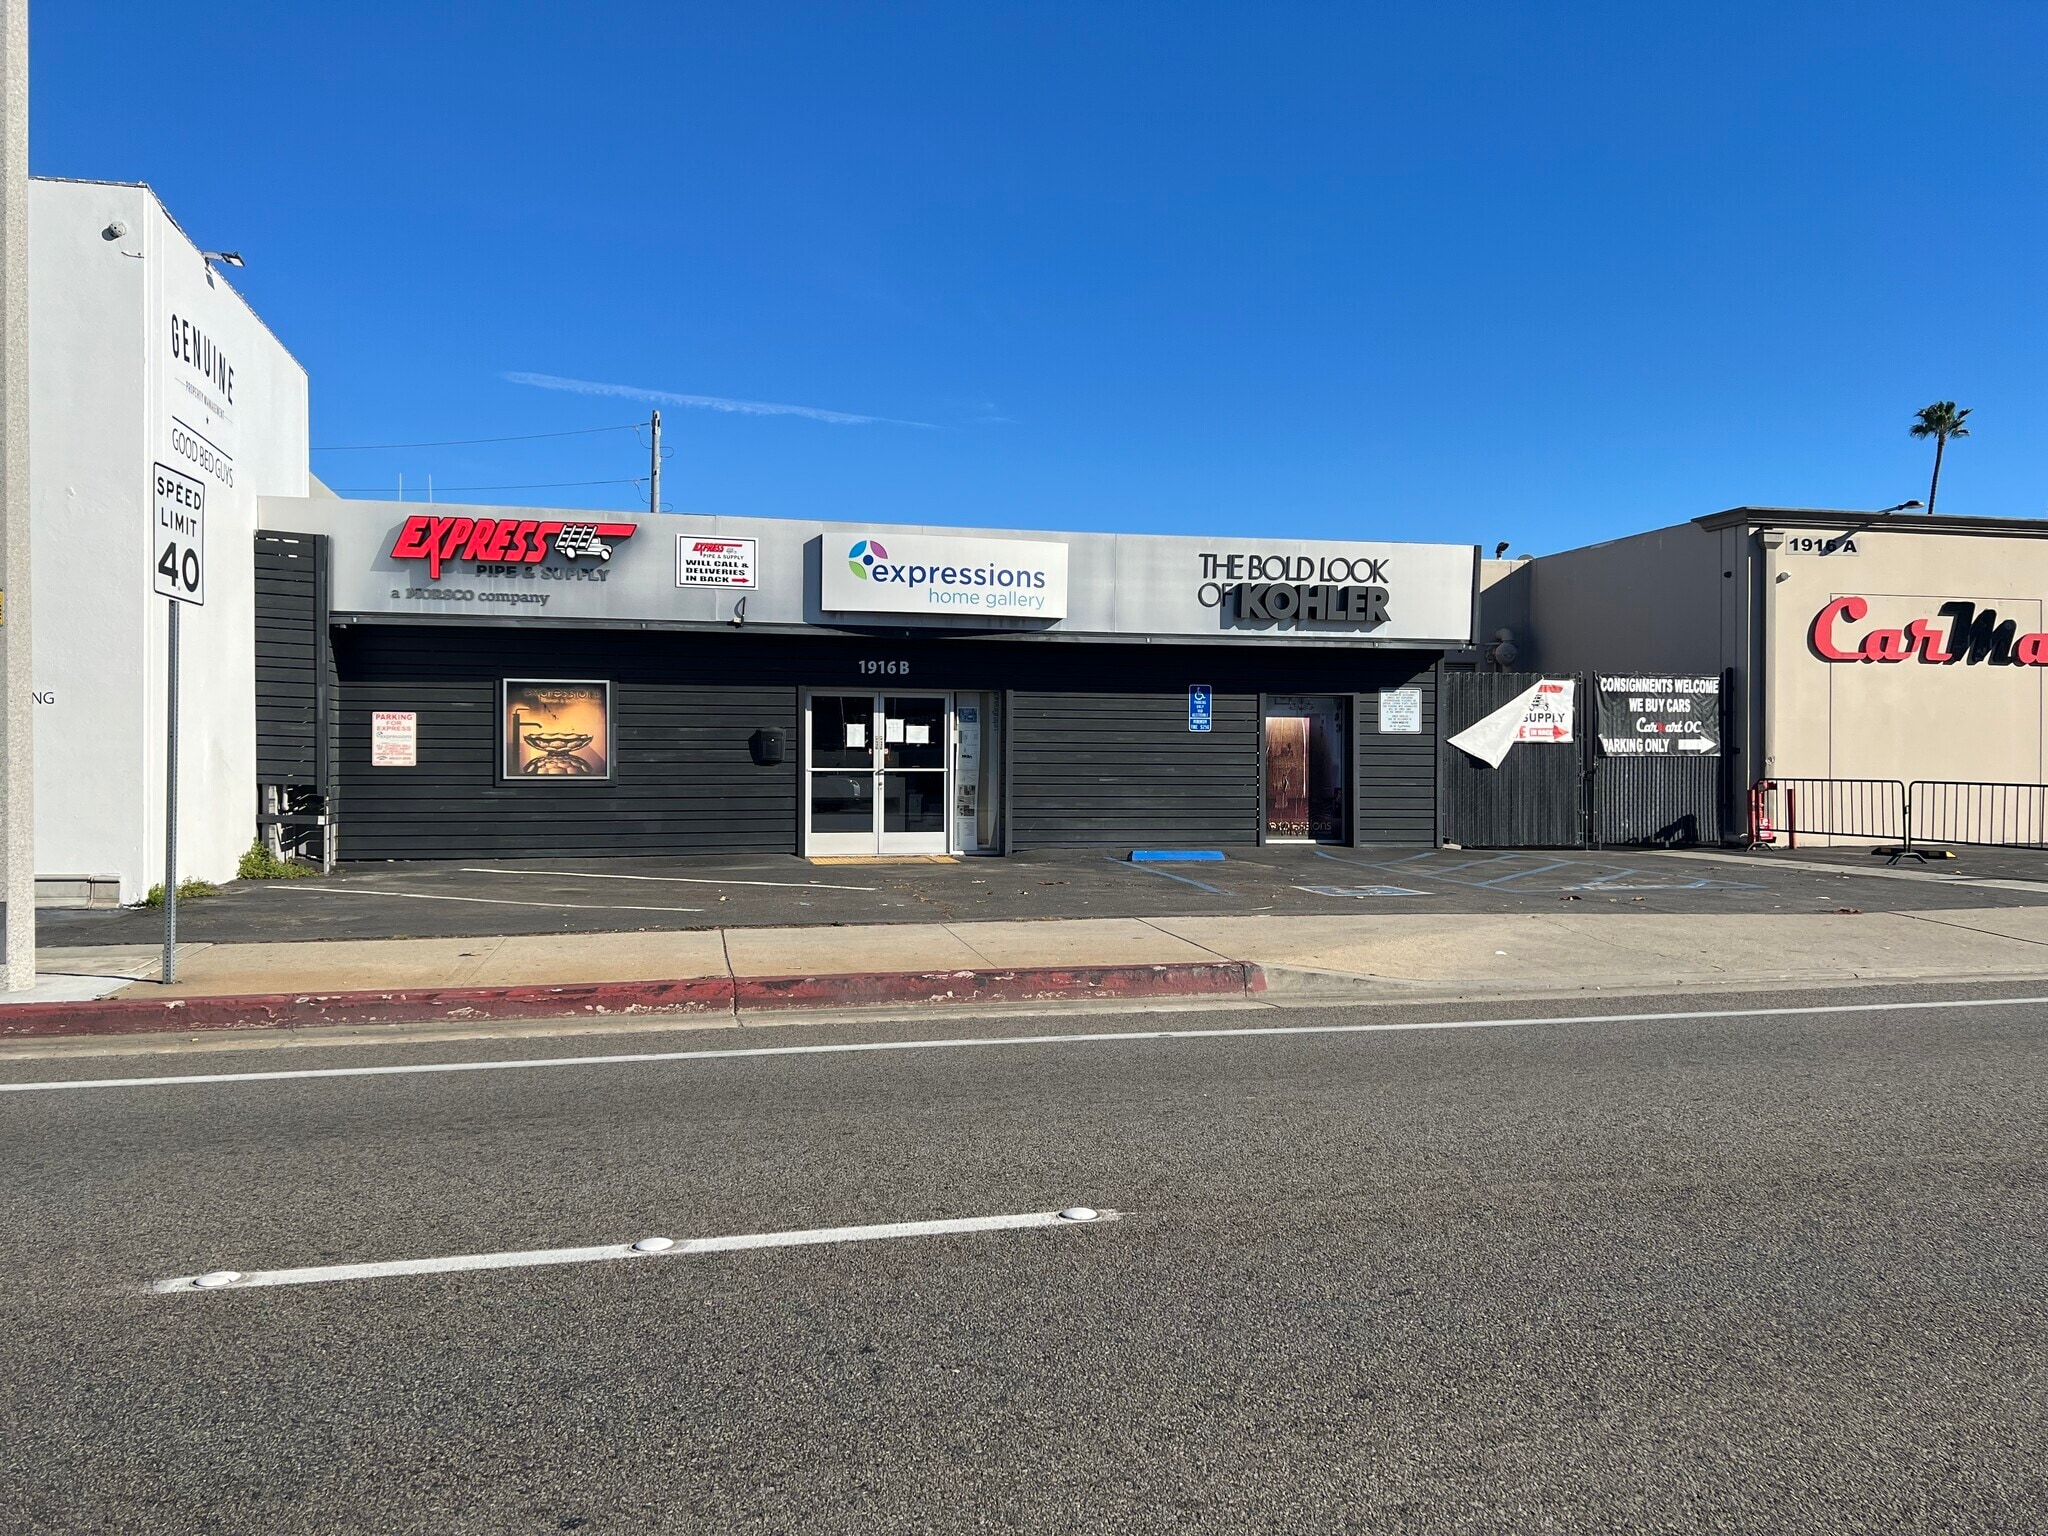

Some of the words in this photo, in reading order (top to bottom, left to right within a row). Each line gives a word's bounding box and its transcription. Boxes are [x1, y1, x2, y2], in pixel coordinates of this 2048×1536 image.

[171, 313, 234, 406] GENUINE
[172, 428, 198, 462] GOOD
[199, 445, 214, 474] BED
[215, 457, 234, 488] GUYS
[157, 476, 201, 510] SPEED
[161, 507, 197, 537] LIMIT
[390, 515, 637, 579] EXPRESS
[692, 542, 743, 556] EXPRESS
[1789, 538, 1837, 552] 1916
[1843, 539, 1857, 552] A
[158, 542, 200, 593] 40
[476, 564, 516, 578] PIPE
[522, 566, 536, 579] &
[540, 567, 610, 582] SUPPLY
[686, 559, 711, 567] WILL
[714, 560, 739, 568] CALL
[686, 567, 745, 576] DELIVERIES
[1198, 553, 1244, 580] THE
[1248, 554, 1315, 582] BOLD
[1319, 556, 1390, 584] LOOK
[872, 563, 1046, 589] expressions
[391, 589, 400, 599] a
[405, 587, 474, 601] MORSCO
[478, 591, 550, 606] company
[929, 588, 980, 604] home
[985, 591, 1045, 610] gallery
[1197, 582, 1234, 608] OF
[1235, 582, 1392, 623] KOHLER
[1600, 677, 1673, 693] CONSIGNMENTS
[1674, 679, 1719, 693] WELCOME
[1629, 698, 1644, 712] WE
[1645, 698, 1665, 712] BUY
[1666, 698, 1691, 713] CARS
[1684, 720, 1702, 733] OC
[1602, 738, 1644, 753] PARKING
[1645, 738, 1670, 753] ONLY
